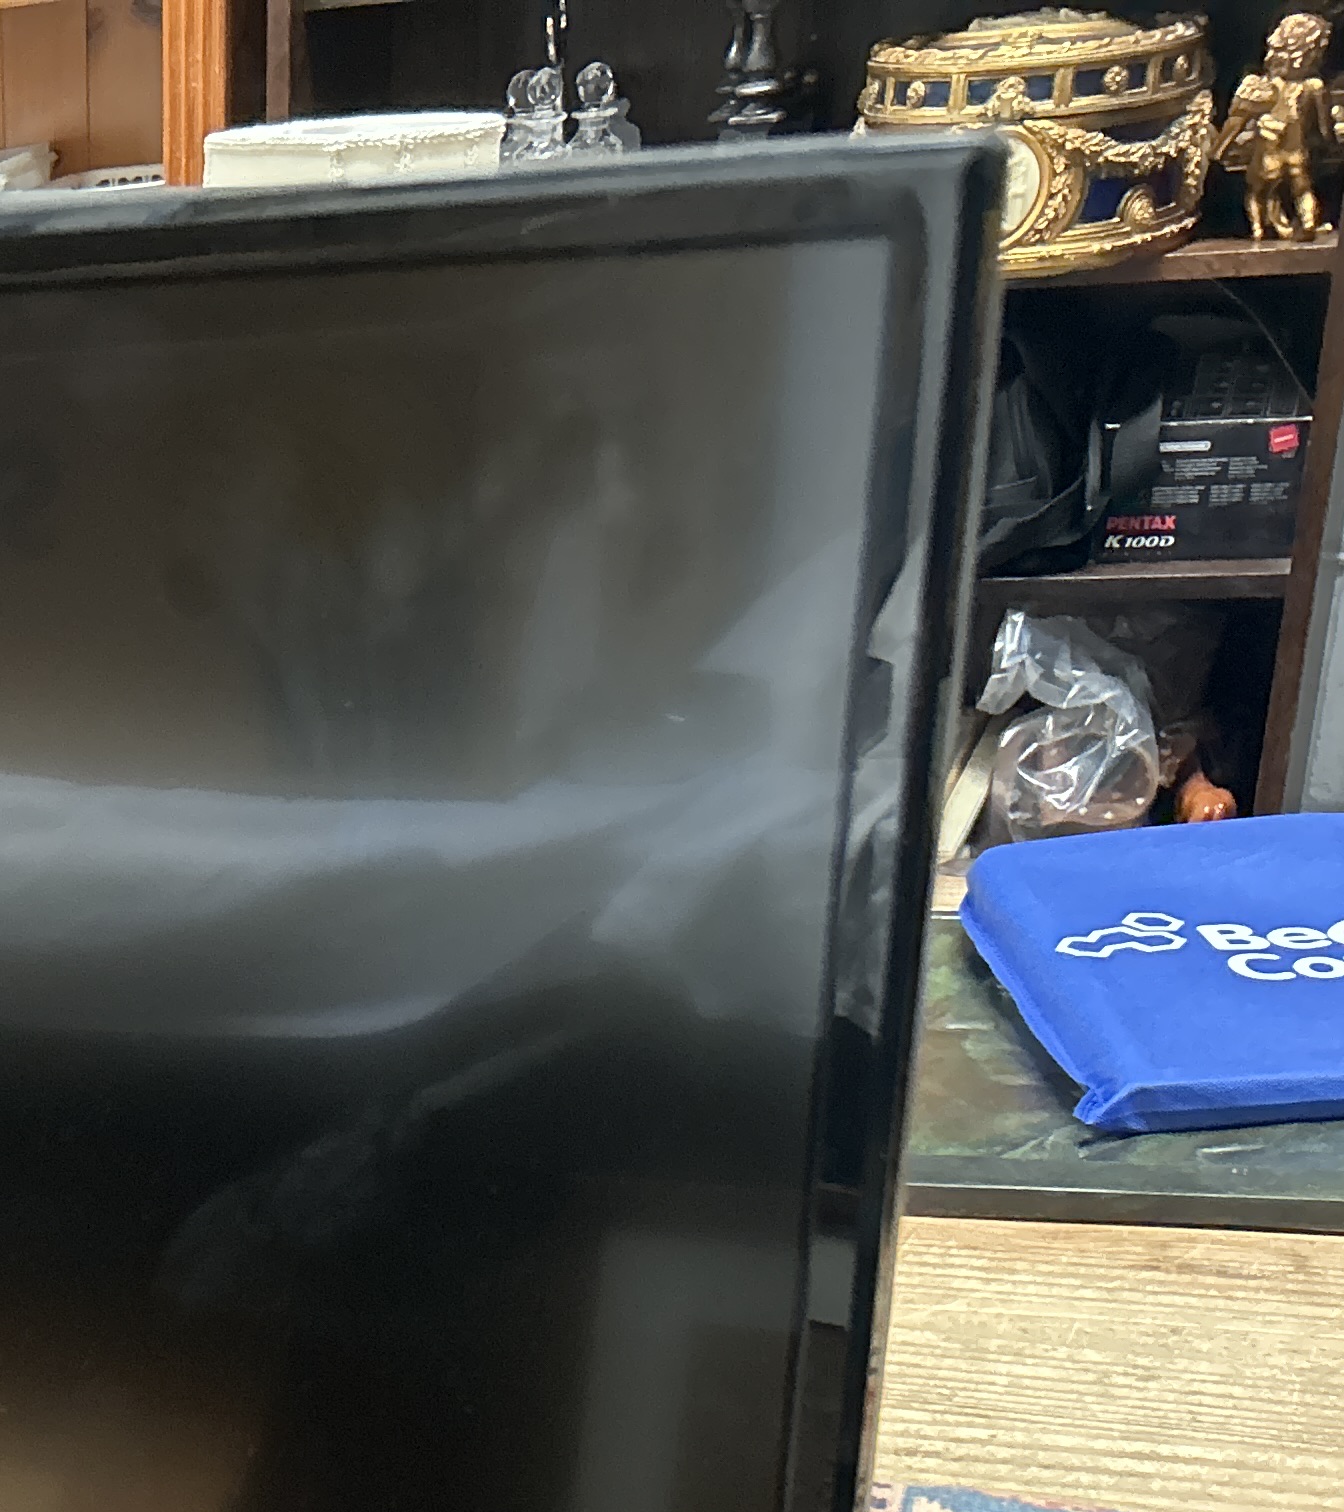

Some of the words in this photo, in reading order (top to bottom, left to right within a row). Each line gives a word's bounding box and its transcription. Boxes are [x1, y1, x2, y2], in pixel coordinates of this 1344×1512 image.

[1105, 515, 1177, 531] PENTAX
[1104, 534, 1176, 549] K100D
[1195, 918, 1344, 951] Be
[1227, 952, 1344, 981] Co
